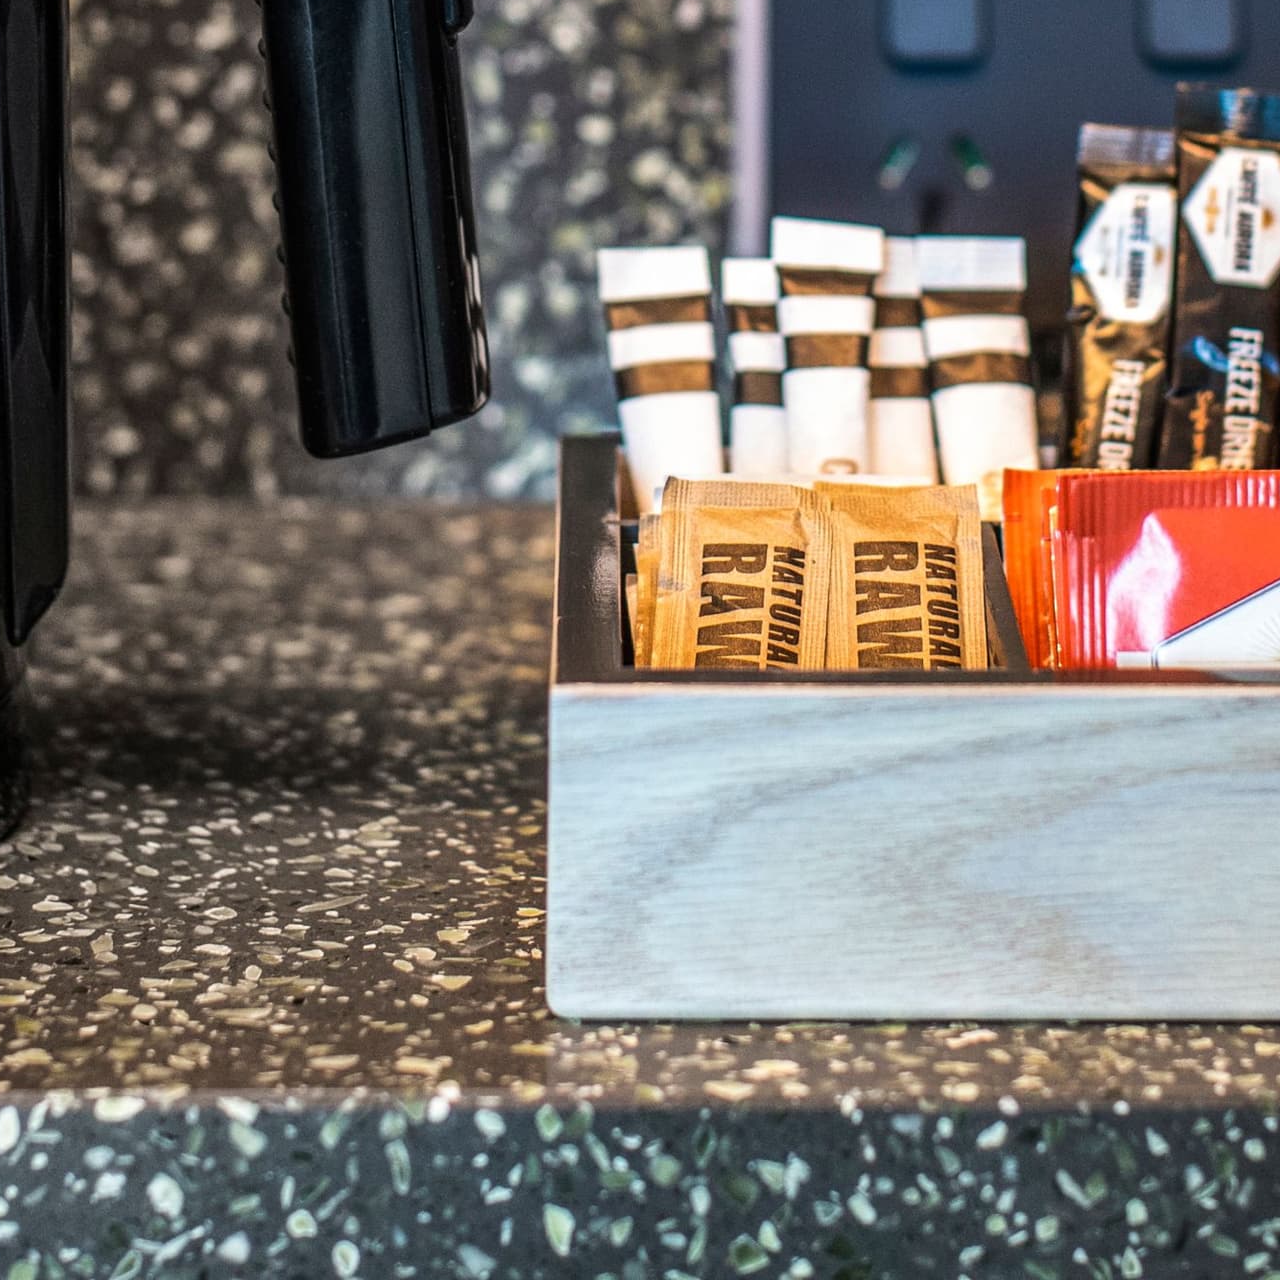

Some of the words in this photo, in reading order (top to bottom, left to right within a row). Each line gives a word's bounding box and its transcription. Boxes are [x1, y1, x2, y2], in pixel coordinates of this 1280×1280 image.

[1101, 359, 1145, 440] FREEZE
[1225, 326, 1263, 416] FREEZE
[1220, 415, 1257, 469] DRIE
[695, 542, 769, 670] RAW
[766, 546, 806, 670] NATURA
[854, 541, 925, 670] RAW
